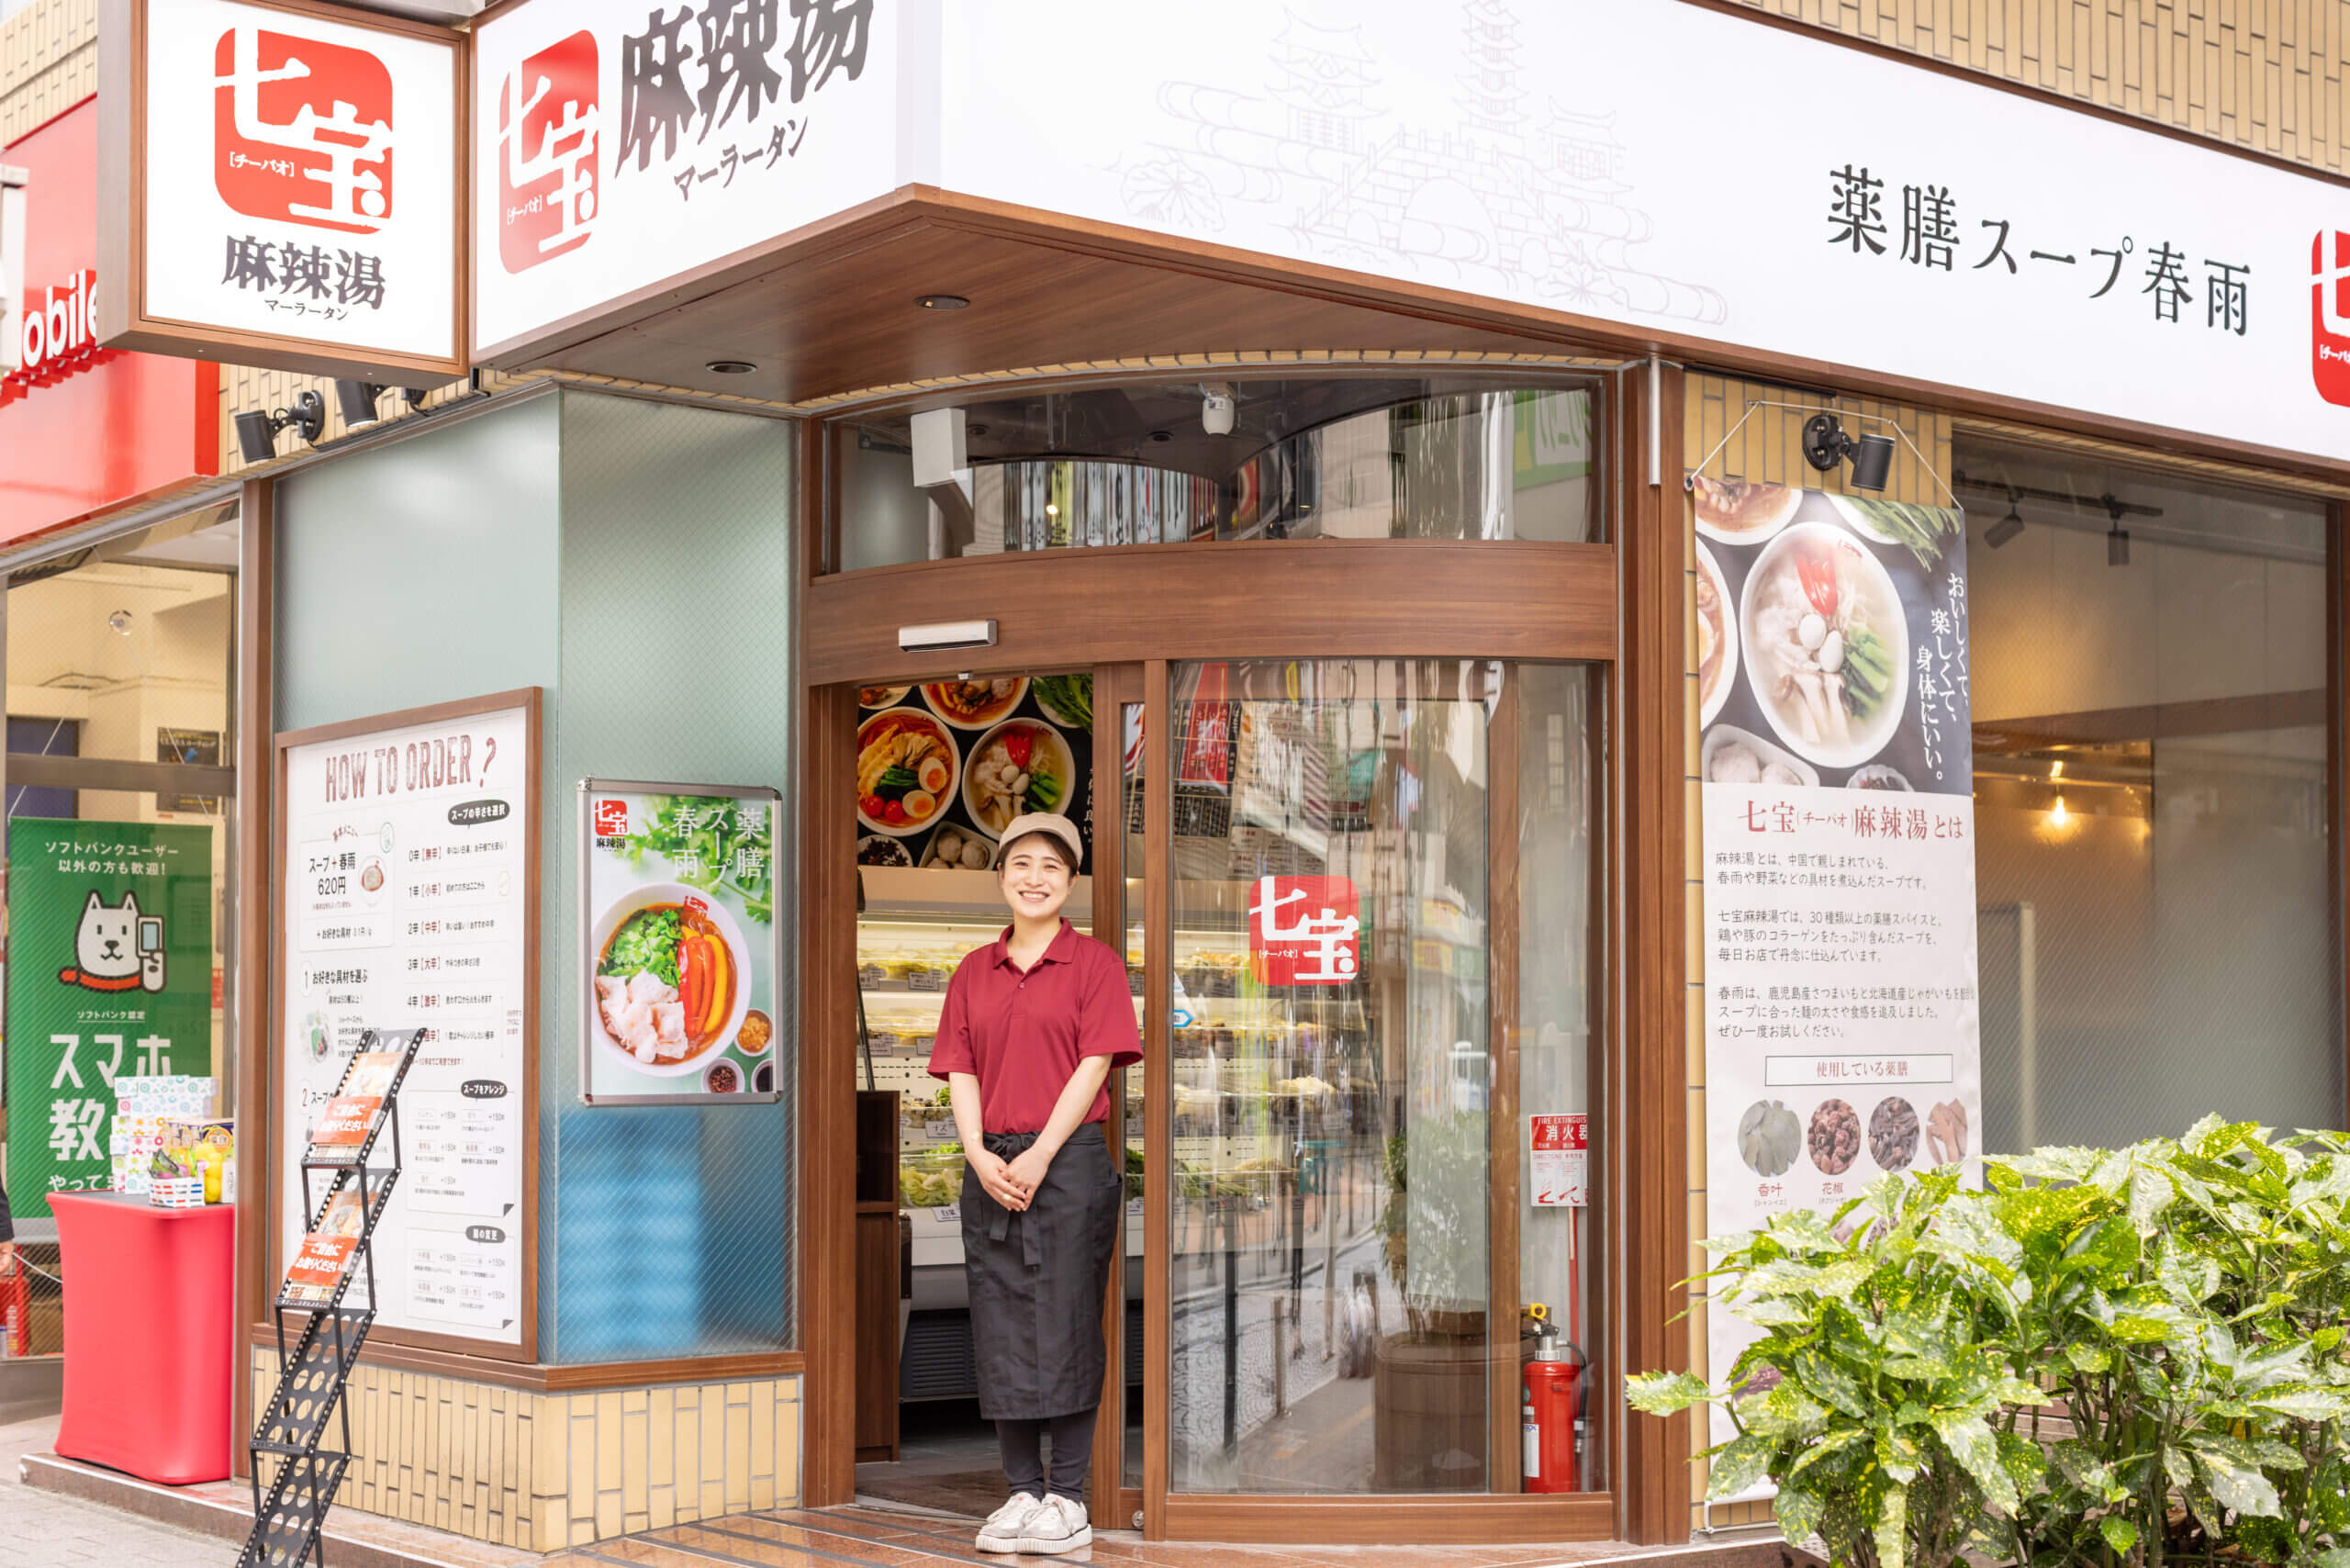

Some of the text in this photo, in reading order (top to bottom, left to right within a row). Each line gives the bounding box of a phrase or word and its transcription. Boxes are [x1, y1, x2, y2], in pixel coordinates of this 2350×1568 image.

[215, 27, 393, 229] 七宝
[499, 62, 599, 254] 七宝
[673, 116, 809, 202] マーラータン
[221, 235, 386, 310] 麻辣湯
[1827, 163, 2252, 337] 薬膳スープ春雨
[264, 299, 349, 322] マーラータン
[1930, 608, 1957, 722] 楽しくて、
[1947, 572, 1969, 707] おいしくて、
[1916, 644, 1943, 780] 身体にいい。
[325, 751, 367, 803] HOW
[375, 745, 397, 796] TO
[406, 734, 472, 792] ORDER
[45, 841, 179, 857] ソフトバンクユーザー
[672, 805, 700, 879] 春雨
[708, 809, 733, 885] スープ
[735, 807, 765, 879] 薬膳
[318, 876, 346, 896] 620円
[1248, 875, 1360, 980] 七宝
[312, 969, 369, 985] お好きな具材を選ぶ
[50, 1034, 172, 1090] スマホ
[1816, 1060, 1908, 1079] 使用している薬膳
[1538, 1116, 1551, 1125] FIRE
